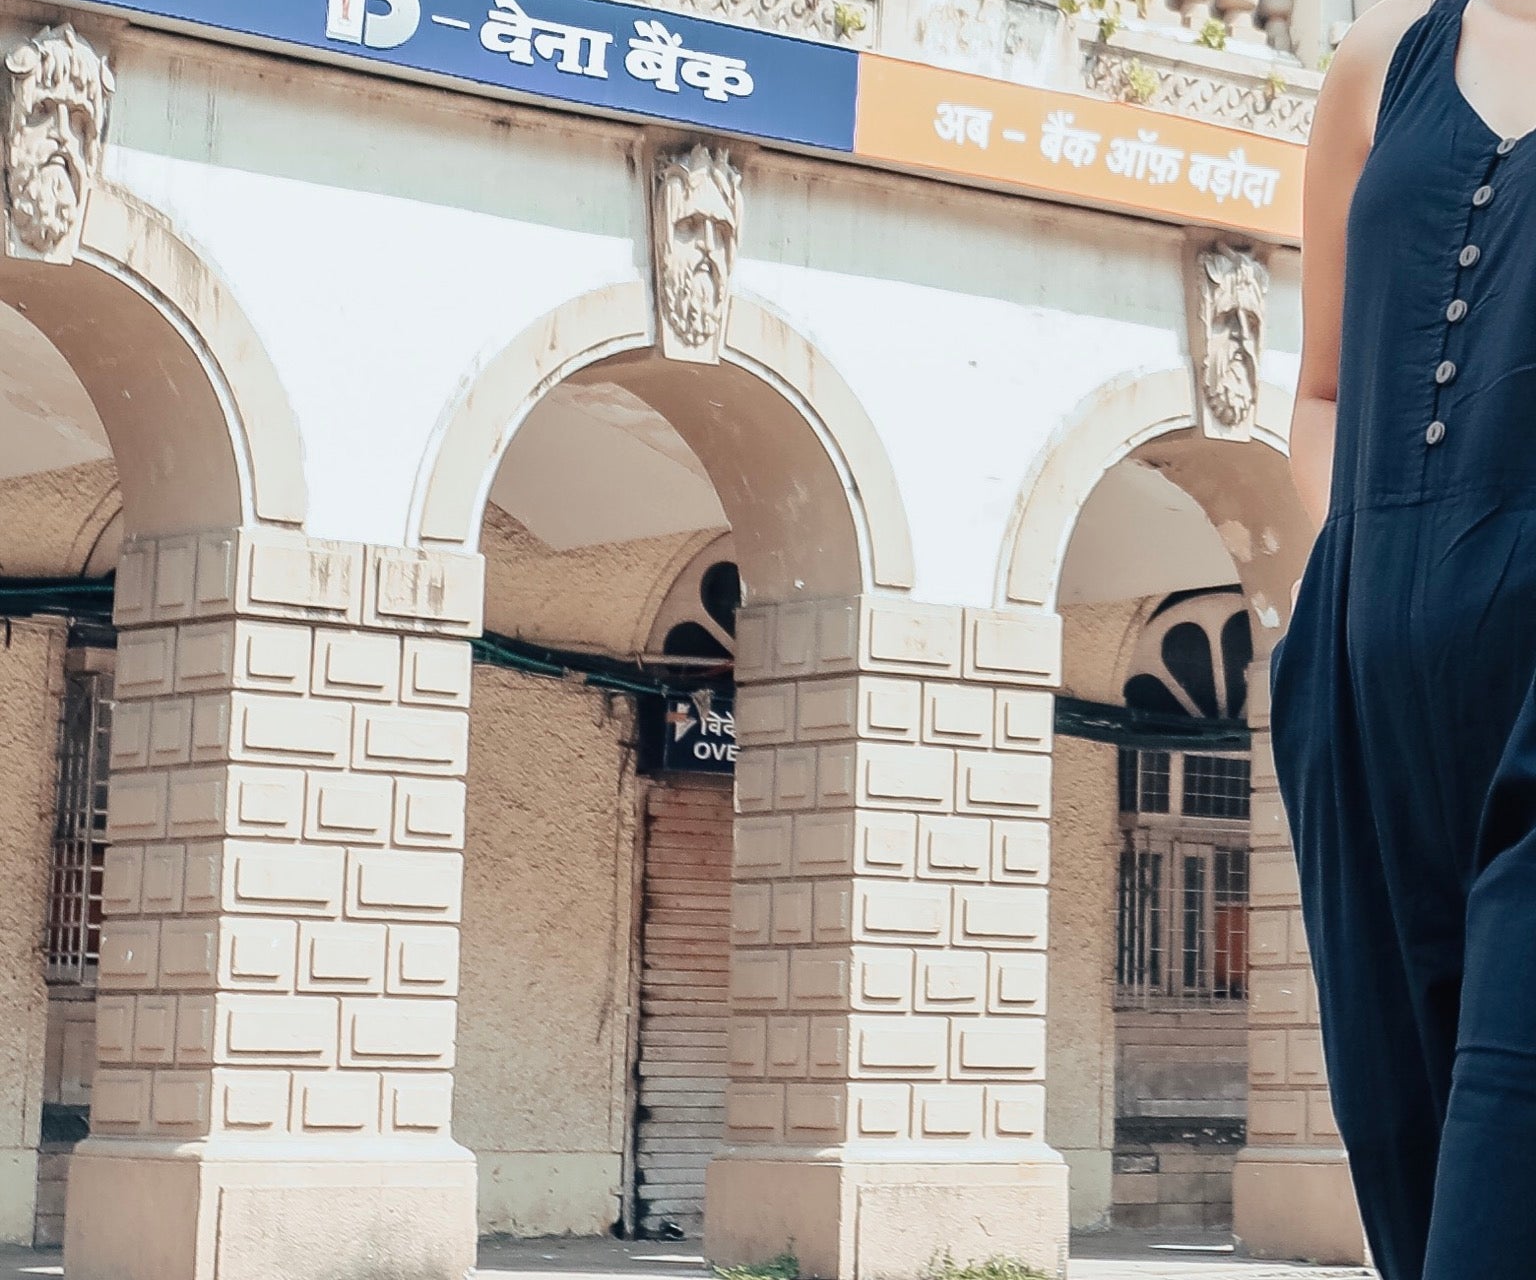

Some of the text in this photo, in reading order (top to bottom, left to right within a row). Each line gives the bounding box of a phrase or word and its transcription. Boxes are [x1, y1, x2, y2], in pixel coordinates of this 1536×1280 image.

[624, 19, 754, 102] बैंक
[933, 101, 994, 150] अब
[1039, 109, 1102, 168] बैंक
